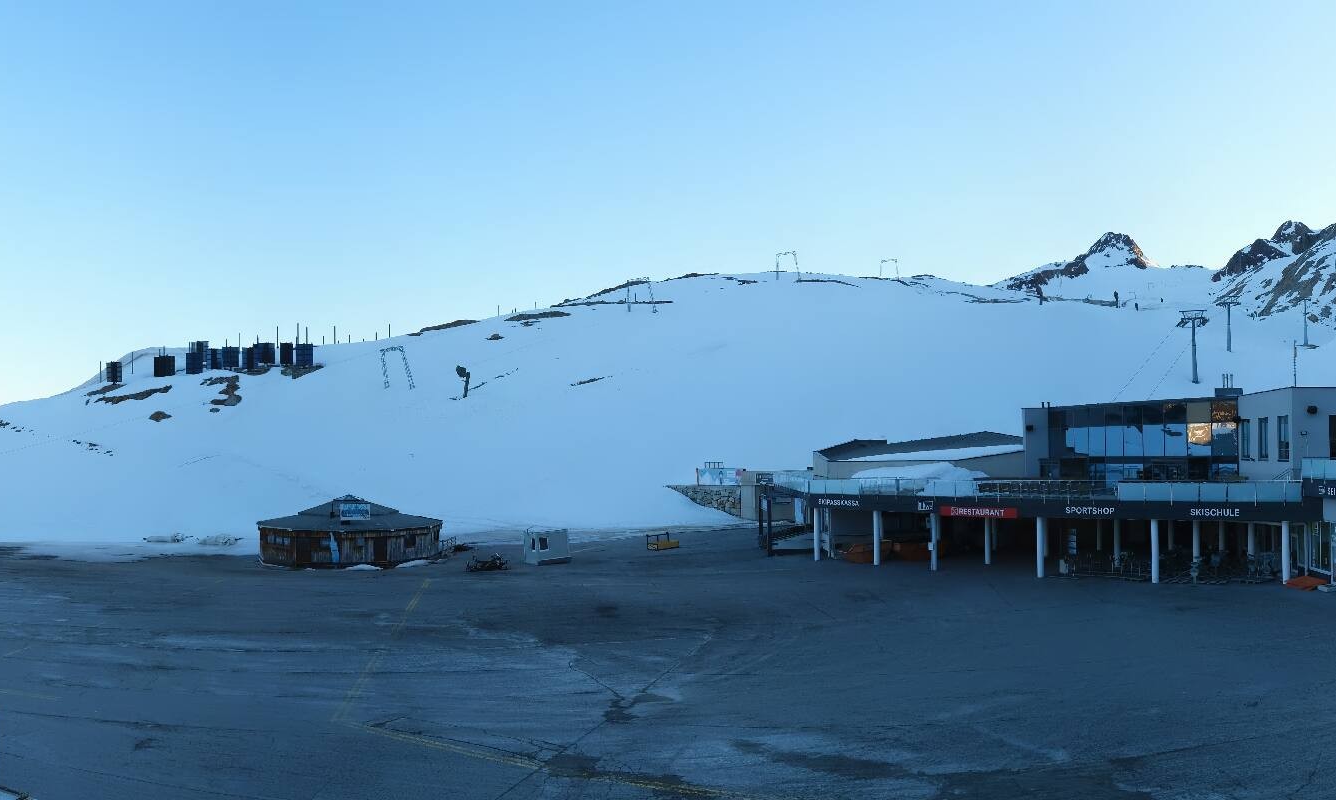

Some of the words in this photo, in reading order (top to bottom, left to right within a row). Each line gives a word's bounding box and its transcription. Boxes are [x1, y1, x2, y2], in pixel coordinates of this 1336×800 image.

[818, 498, 860, 507] SKIPASSKASSA
[958, 507, 1005, 517] RESTAURANT
[1065, 506, 1115, 515] SPORTSHOP
[1190, 508, 1240, 517] SKISCHULE
